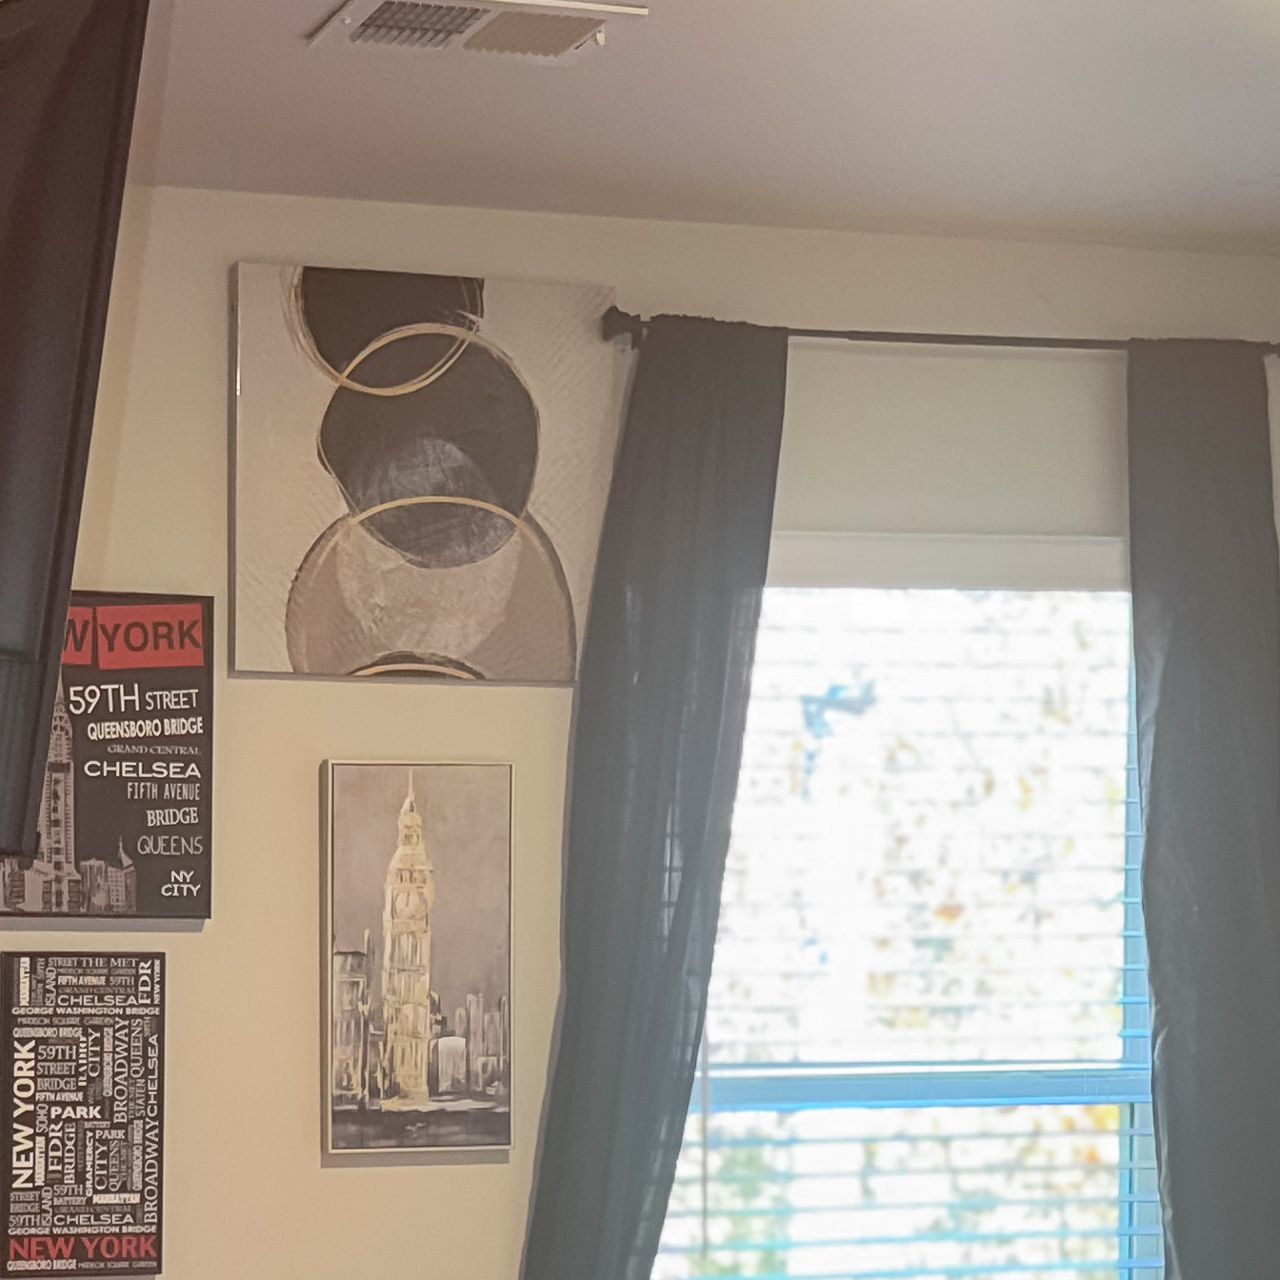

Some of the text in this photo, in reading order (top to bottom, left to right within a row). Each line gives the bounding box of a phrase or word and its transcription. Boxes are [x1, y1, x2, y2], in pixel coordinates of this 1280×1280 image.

[100, 620, 202, 653] YORK
[69, 683, 199, 715] 59TH STREET
[87, 717, 204, 741] QUEENSBORO BRIDGE
[107, 745, 200, 756] GRAND CENTRAL
[84, 760, 202, 778] CHELSEA
[127, 782, 200, 801] FIFTH AVENUE
[146, 807, 199, 827] BRIDGE
[137, 835, 203, 856] QUEENS
[171, 870, 195, 883] NY
[161, 884, 202, 897] CITY
[48, 957, 79, 967] STREET
[45, 967, 56, 1006] ISLAND
[139, 960, 152, 1004] FDR
[12, 1007, 160, 1015] GEORGE WASHINGTON BRIDGE
[57, 995, 138, 1006] CHELSEA
[37, 1045, 77, 1060] 59TH
[87, 1027, 100, 1077] CITY
[130, 1018, 144, 1078] QUEENS
[36, 1062, 77, 1075] STREET
[114, 1016, 129, 1123] BROADWAY
[147, 1033, 159, 1117] CHELSEA
[37, 1078, 77, 1091] BRIDGE
[135, 1079, 146, 1117] STATEN
[12, 1039, 36, 1188] NEW YORK
[36, 1103, 49, 1133] SOHO
[50, 1106, 102, 1119] PARK
[95, 1130, 126, 1139] PARK
[48, 1121, 63, 1171] FDR
[64, 1122, 76, 1184] BRIDGE
[86, 1130, 94, 1197] GRAMERCY
[94, 1141, 108, 1190] CITY
[109, 1140, 122, 1192] QUEENS
[144, 1117, 159, 1223] BROADWAY
[9, 1192, 40, 1202] STREET
[53, 1184, 84, 1196] 59TH
[42, 1187, 53, 1227] ISLAND
[7, 1214, 40, 1227] 59TH
[7, 1225, 157, 1236] GEORGE WASHINGTON BRIDGE
[53, 1213, 135, 1226] CHELSEA
[9, 1234, 159, 1261] NEW YORK
